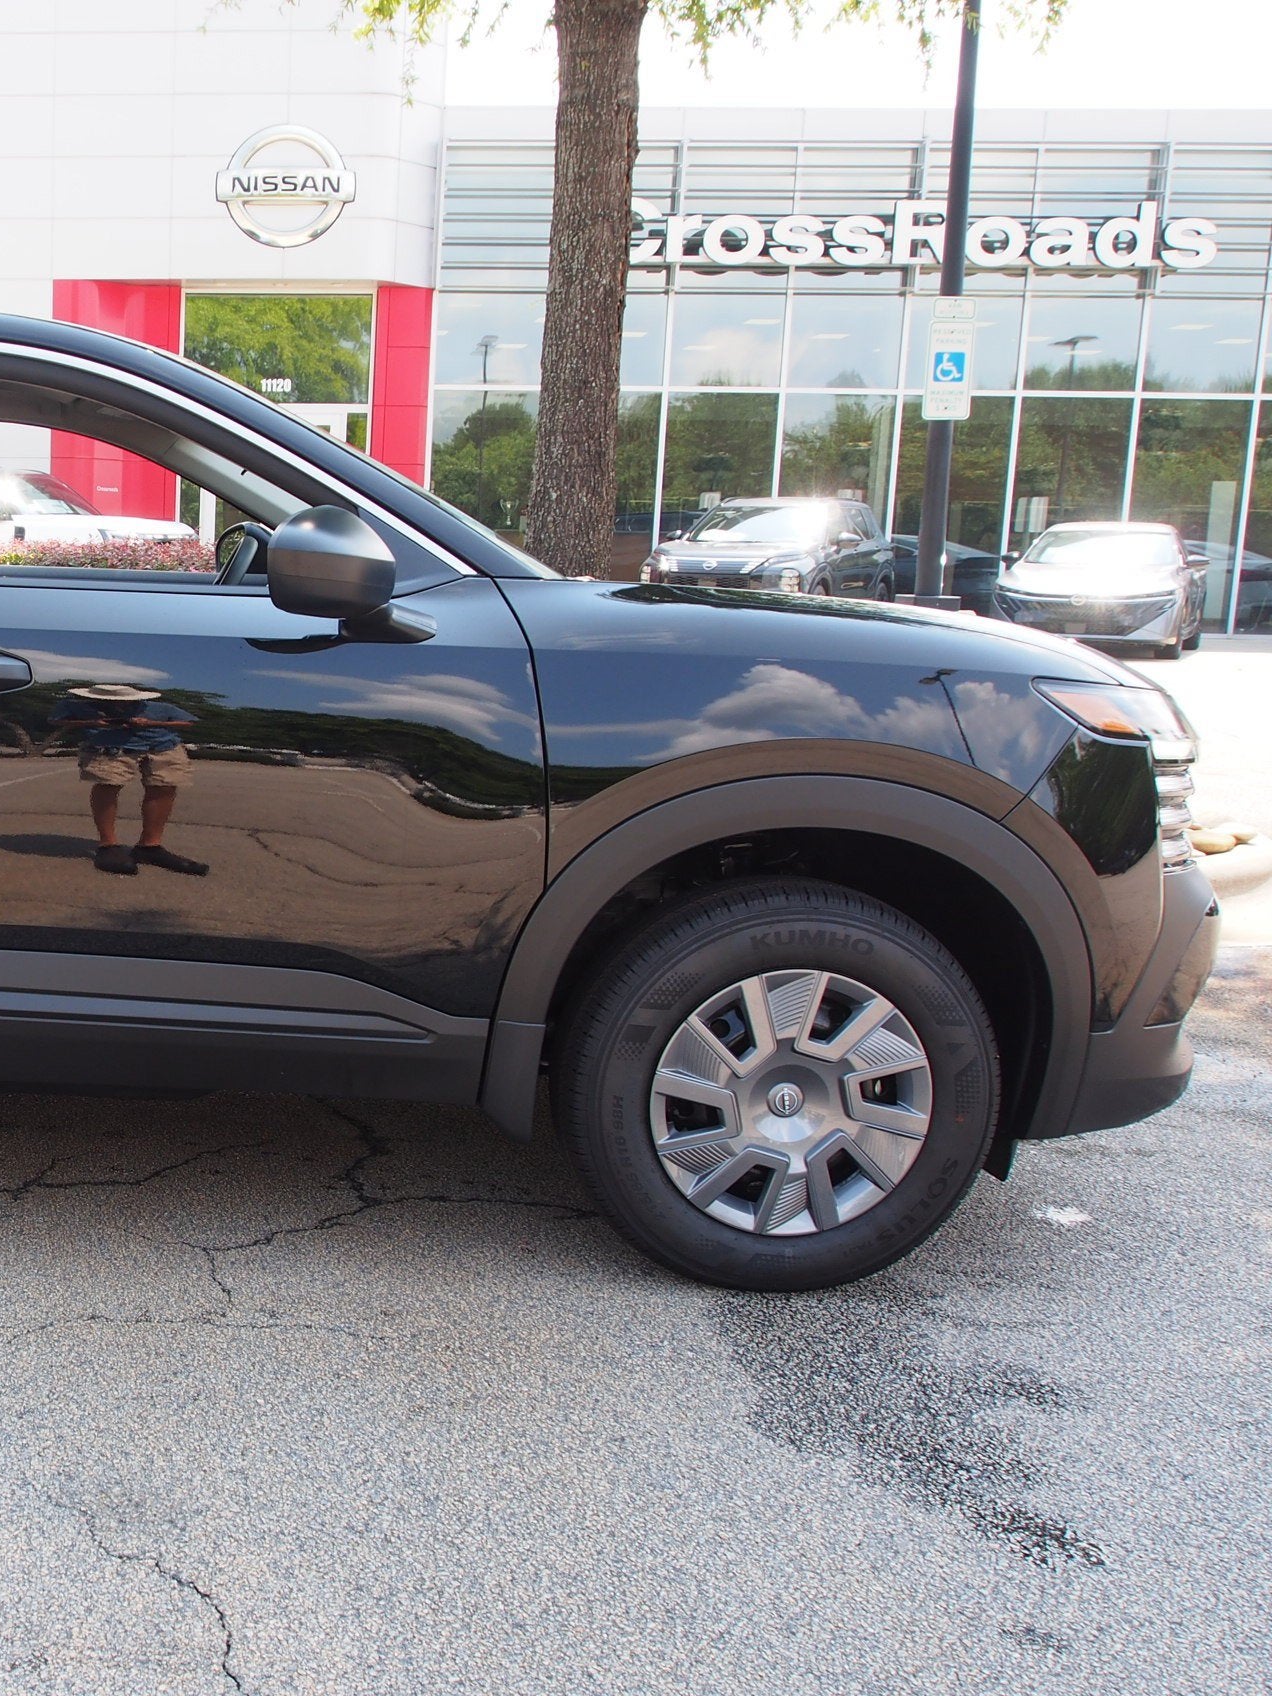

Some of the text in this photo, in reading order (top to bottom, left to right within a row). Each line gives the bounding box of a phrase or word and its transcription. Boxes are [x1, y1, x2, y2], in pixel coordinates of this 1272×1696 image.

[231, 175, 341, 193] NISSAN
[260, 378, 292, 393] 11120
[748, 928, 876, 958] KUMHO
[872, 1155, 960, 1250] SOLUS
